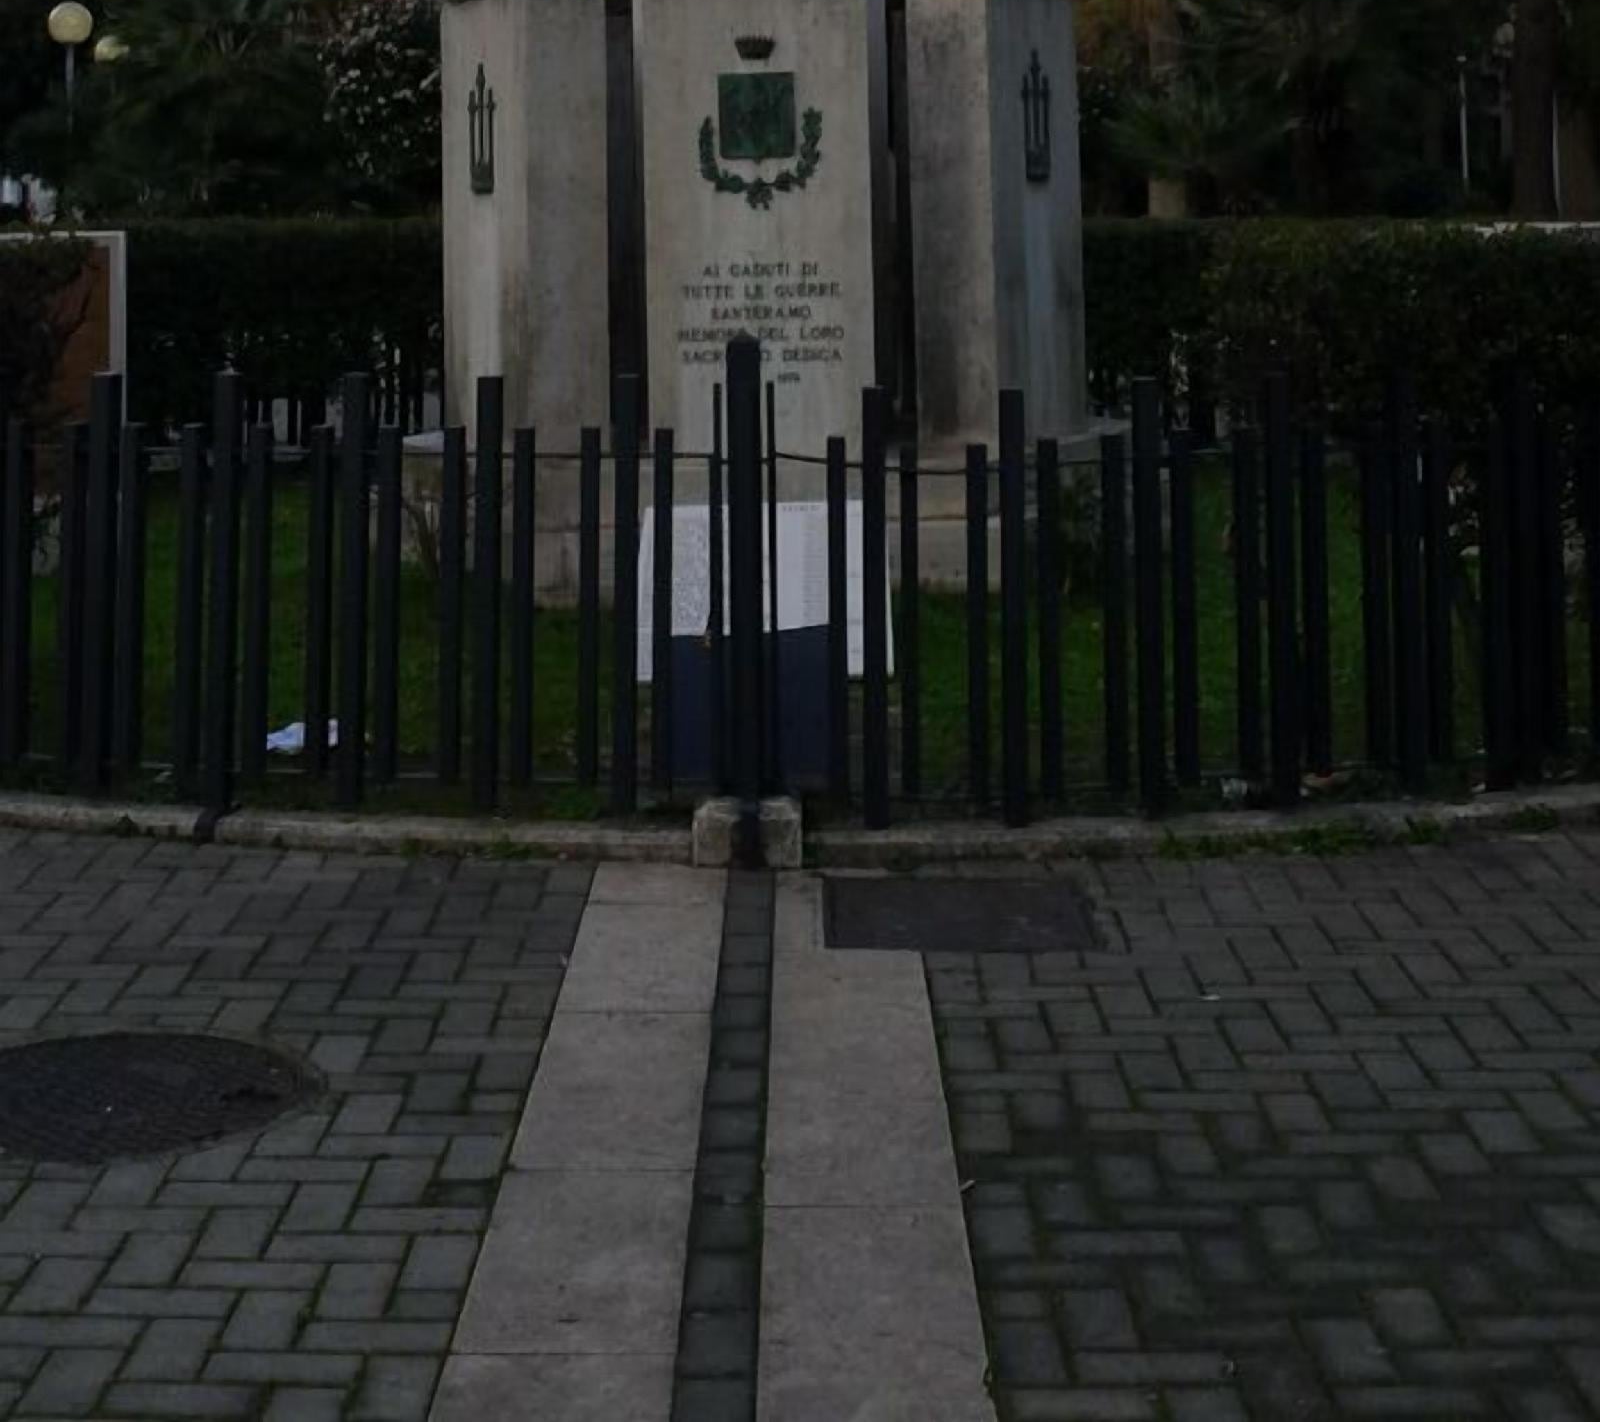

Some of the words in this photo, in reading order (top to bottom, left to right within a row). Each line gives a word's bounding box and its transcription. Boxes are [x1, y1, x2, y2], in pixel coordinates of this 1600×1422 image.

[730, 263, 790, 277] CADUTI
[801, 262, 817, 276] DI
[682, 284, 733, 299] TUTTE
[774, 282, 841, 298] GUERRE
[798, 325, 844, 340] LORO
